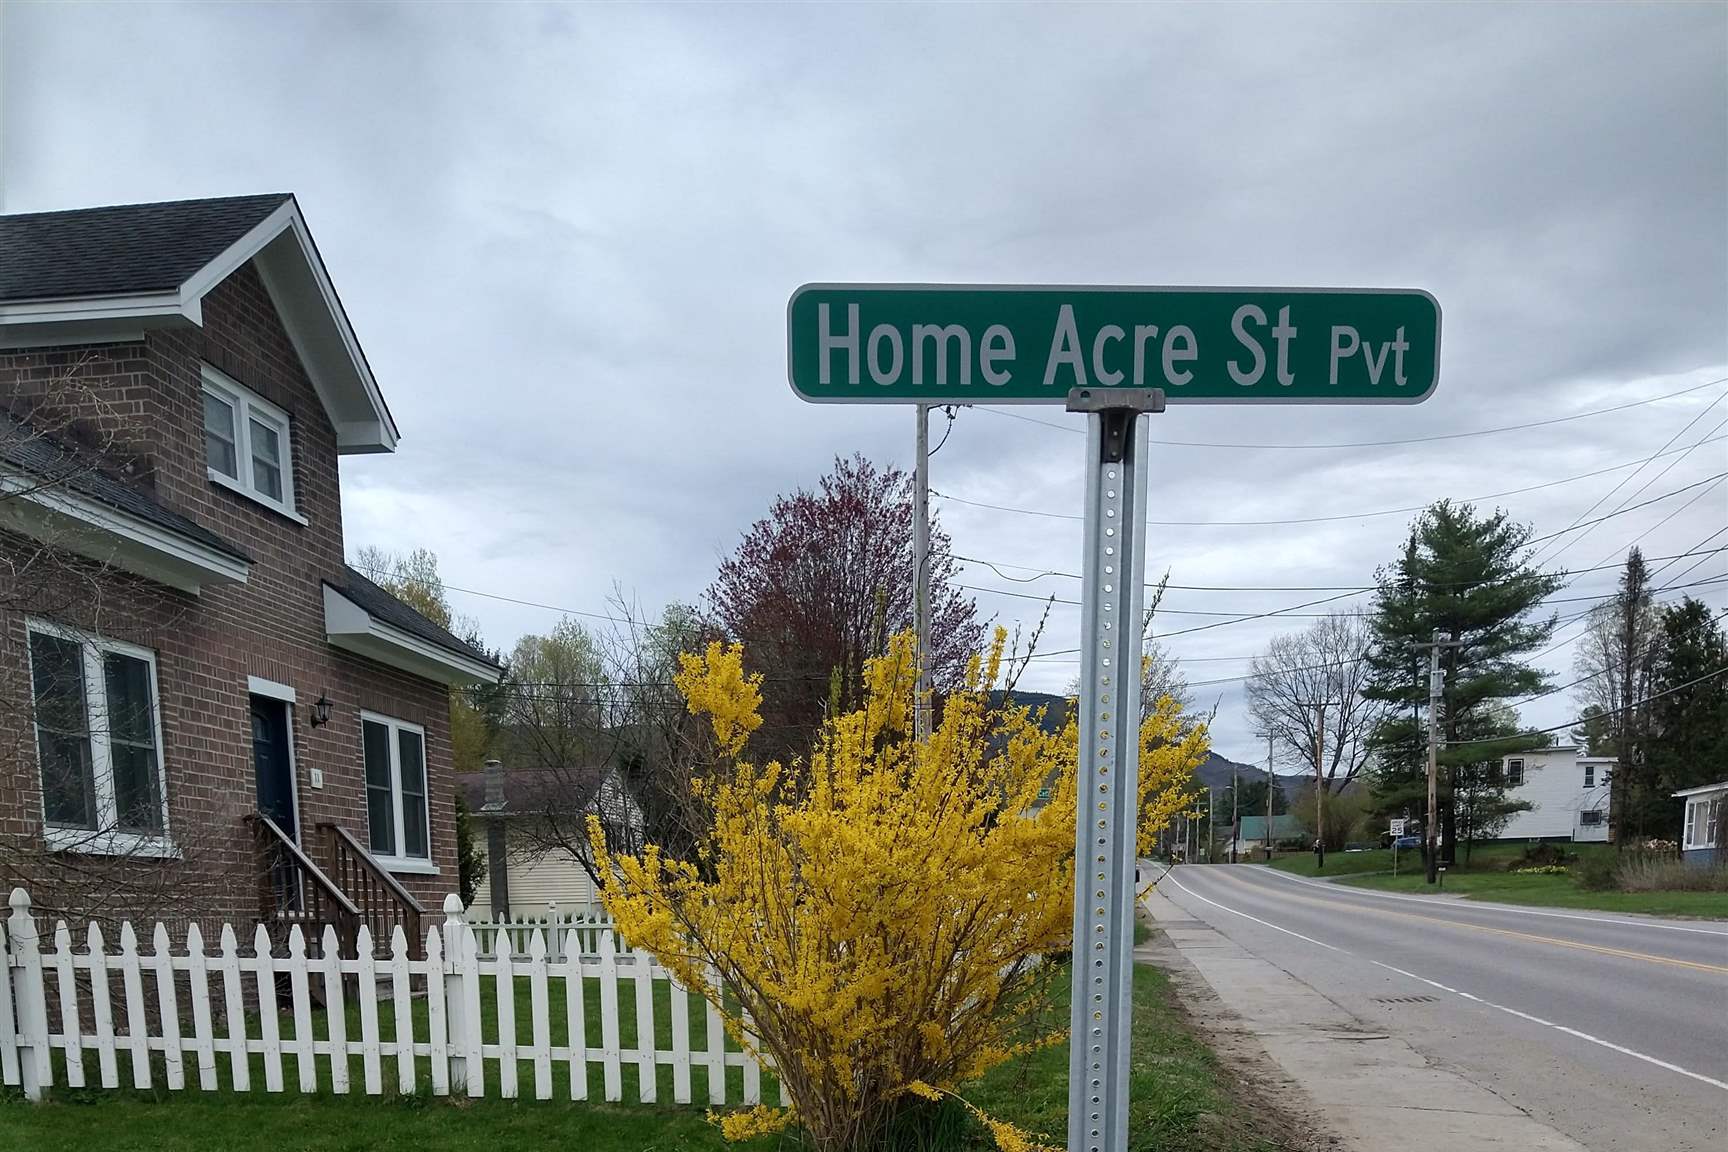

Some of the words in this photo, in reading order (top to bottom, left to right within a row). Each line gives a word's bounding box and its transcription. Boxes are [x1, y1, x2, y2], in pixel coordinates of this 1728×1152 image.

[819, 303, 1016, 386] Home
[1043, 304, 1199, 386] Acre
[1227, 304, 1297, 386] St
[1330, 325, 1410, 386] Pvt
